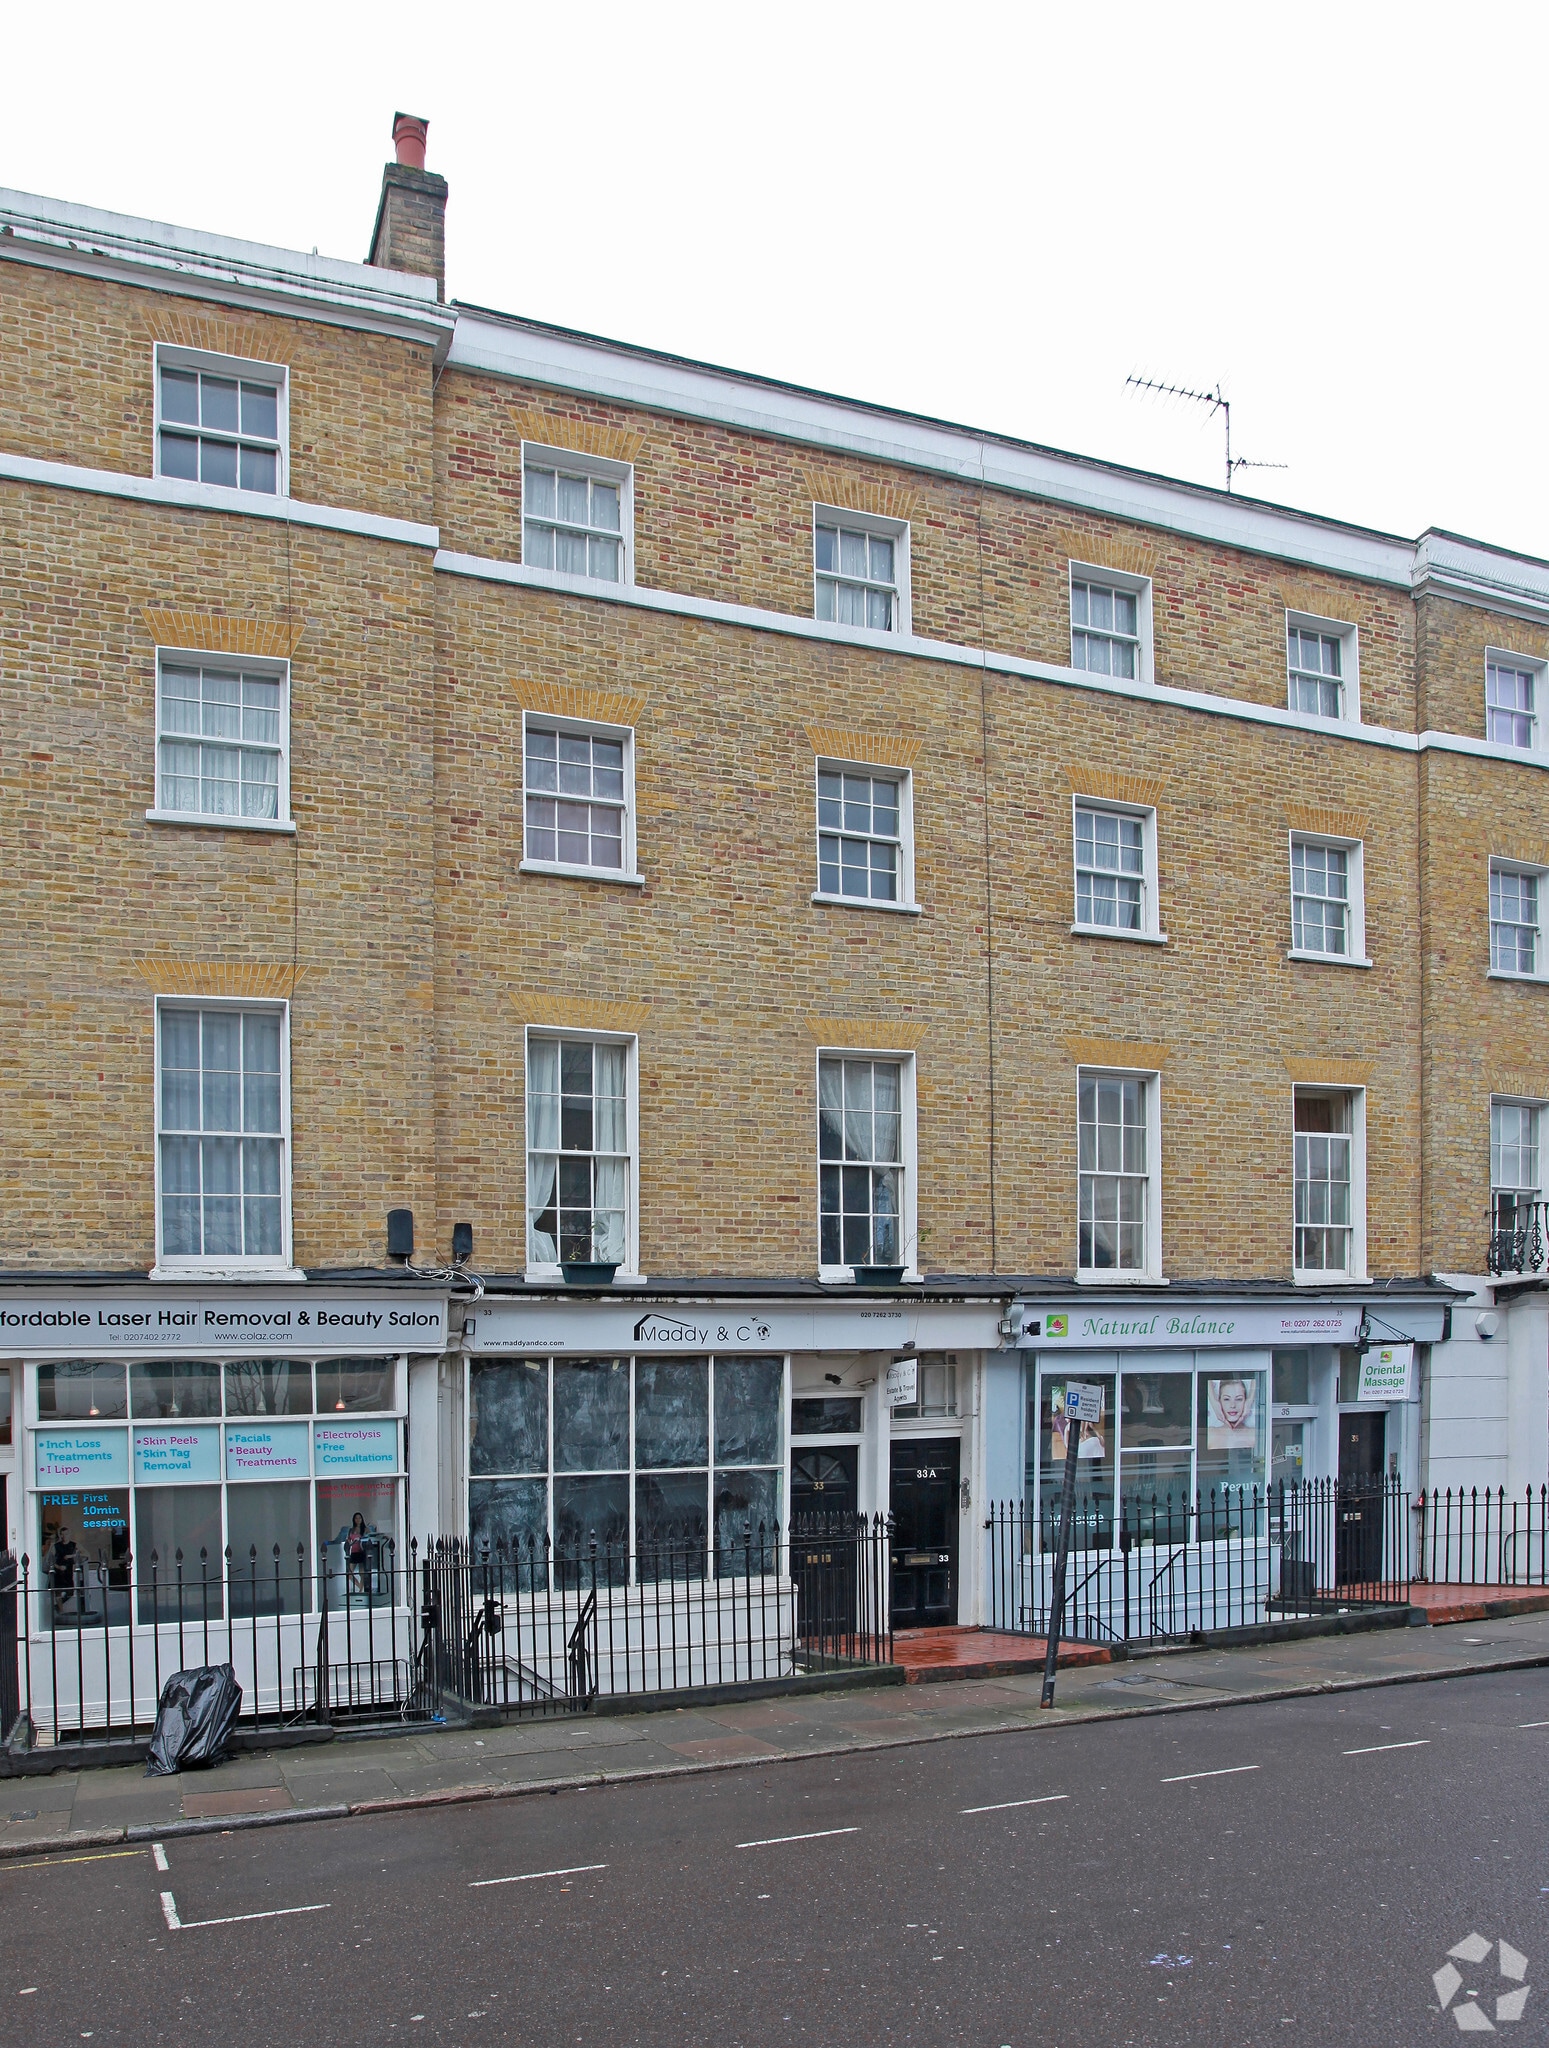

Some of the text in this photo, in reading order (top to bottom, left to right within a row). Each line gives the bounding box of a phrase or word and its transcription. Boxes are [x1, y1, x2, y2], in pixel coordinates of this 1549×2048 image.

[98, 1310, 151, 1327] Laser
[158, 1310, 198, 1326] Hair
[203, 1310, 291, 1327] Removal
[297, 1311, 311, 1326] &
[317, 1310, 383, 1329] Beauty
[388, 1311, 440, 1327] Salon
[1281, 1320, 1293, 1328] Tel:
[1293, 1320, 1311, 1328] 0207
[1326, 1319, 1342, 1327] 0725
[1082, 1315, 1235, 1337] Natural Balance
[109, 1333, 181, 1341] Tel: 0207402 2772
[214, 1332, 293, 1341] www.colaz.com
[641, 1325, 709, 1345] Maddy
[717, 1326, 729, 1341] &
[483, 1339, 565, 1347] www.maddyandco.com
[1365, 1363, 1406, 1376] Oriental
[1363, 1377, 1405, 1388] Massage
[1069, 1393, 1078, 1405] P
[1281, 1407, 1290, 1416] 35
[235, 1433, 272, 1443] Facials
[323, 1430, 381, 1440] Electrolysis
[46, 1439, 101, 1449] Inch Loss
[143, 1436, 198, 1446] Skin Peels
[236, 1446, 272, 1455] Beauty
[323, 1443, 345, 1451] Free
[46, 1452, 112, 1462] Treatments
[143, 1448, 190, 1459] Skin Tag
[323, 1453, 393, 1464] Consultations
[143, 1461, 192, 1471] Removal
[236, 1457, 298, 1467] Treatments
[46, 1465, 80, 1476] I Lipo
[813, 1481, 824, 1490] 33
[42, 1493, 109, 1506] FREE First
[83, 1505, 120, 1516] 10min
[83, 1517, 127, 1529] session
[1050, 1514, 1104, 1527] Mssage
[938, 1554, 949, 1563] 33
